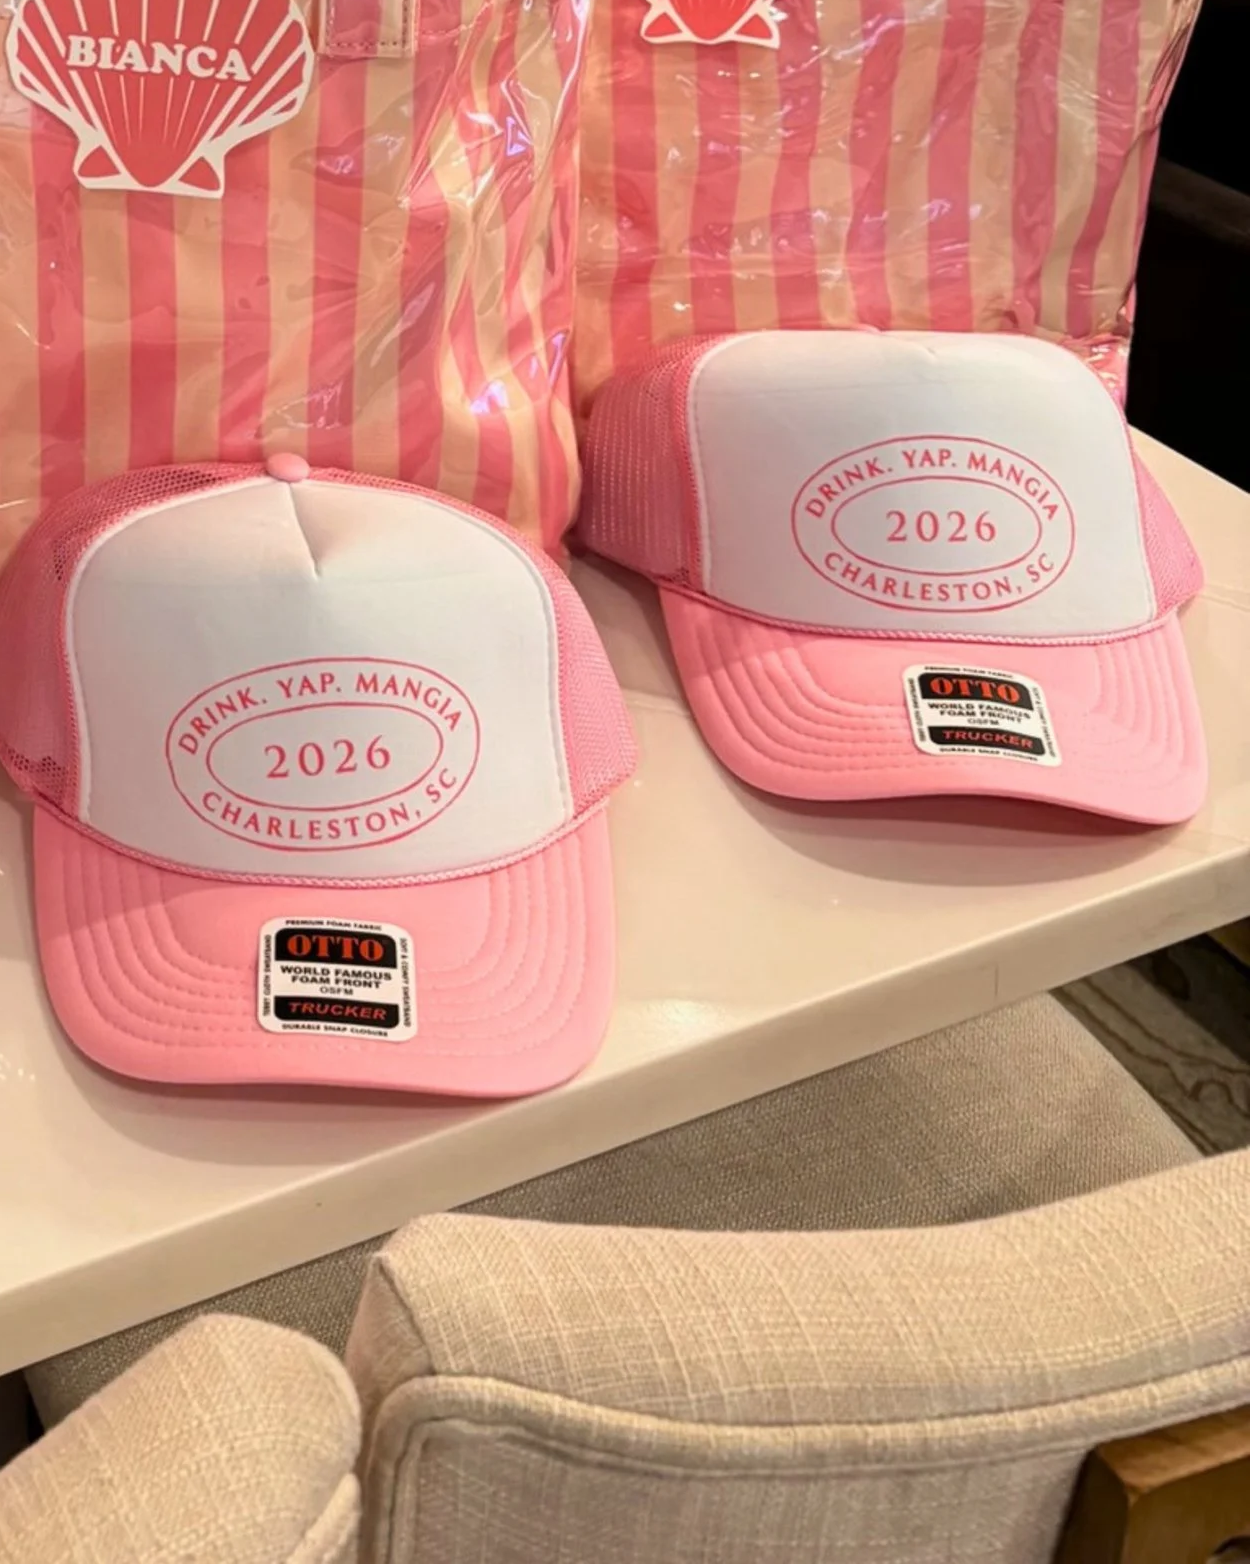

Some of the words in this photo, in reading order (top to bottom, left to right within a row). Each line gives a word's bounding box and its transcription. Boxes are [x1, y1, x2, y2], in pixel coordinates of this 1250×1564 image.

[66, 35, 252, 82] BIANCA
[805, 457, 893, 519] DRINK.
[902, 448, 957, 469] YAP.
[967, 451, 1061, 521] MANGIA
[886, 510, 996, 543] 2026
[824, 552, 1022, 603] CHARLESTON,
[1026, 553, 1054, 583] SC
[931, 677, 1020, 703] OTTO
[178, 688, 268, 755] DRINK.
[277, 673, 341, 699] YAP.
[355, 673, 462, 732] MANGIA
[943, 730, 1033, 748] TRUCKER
[265, 735, 391, 779] 2026
[202, 791, 421, 840] CHARLESTON,
[425, 768, 457, 804] SC
[287, 935, 383, 961] OTTO
[280, 965, 330, 976] WORLD
[334, 969, 392, 981] FAMOUS
[291, 976, 330, 985] FOAM
[335, 978, 381, 988] FRONT
[320, 986, 353, 996] OSFM
[288, 1002, 387, 1020] TRUCKER
